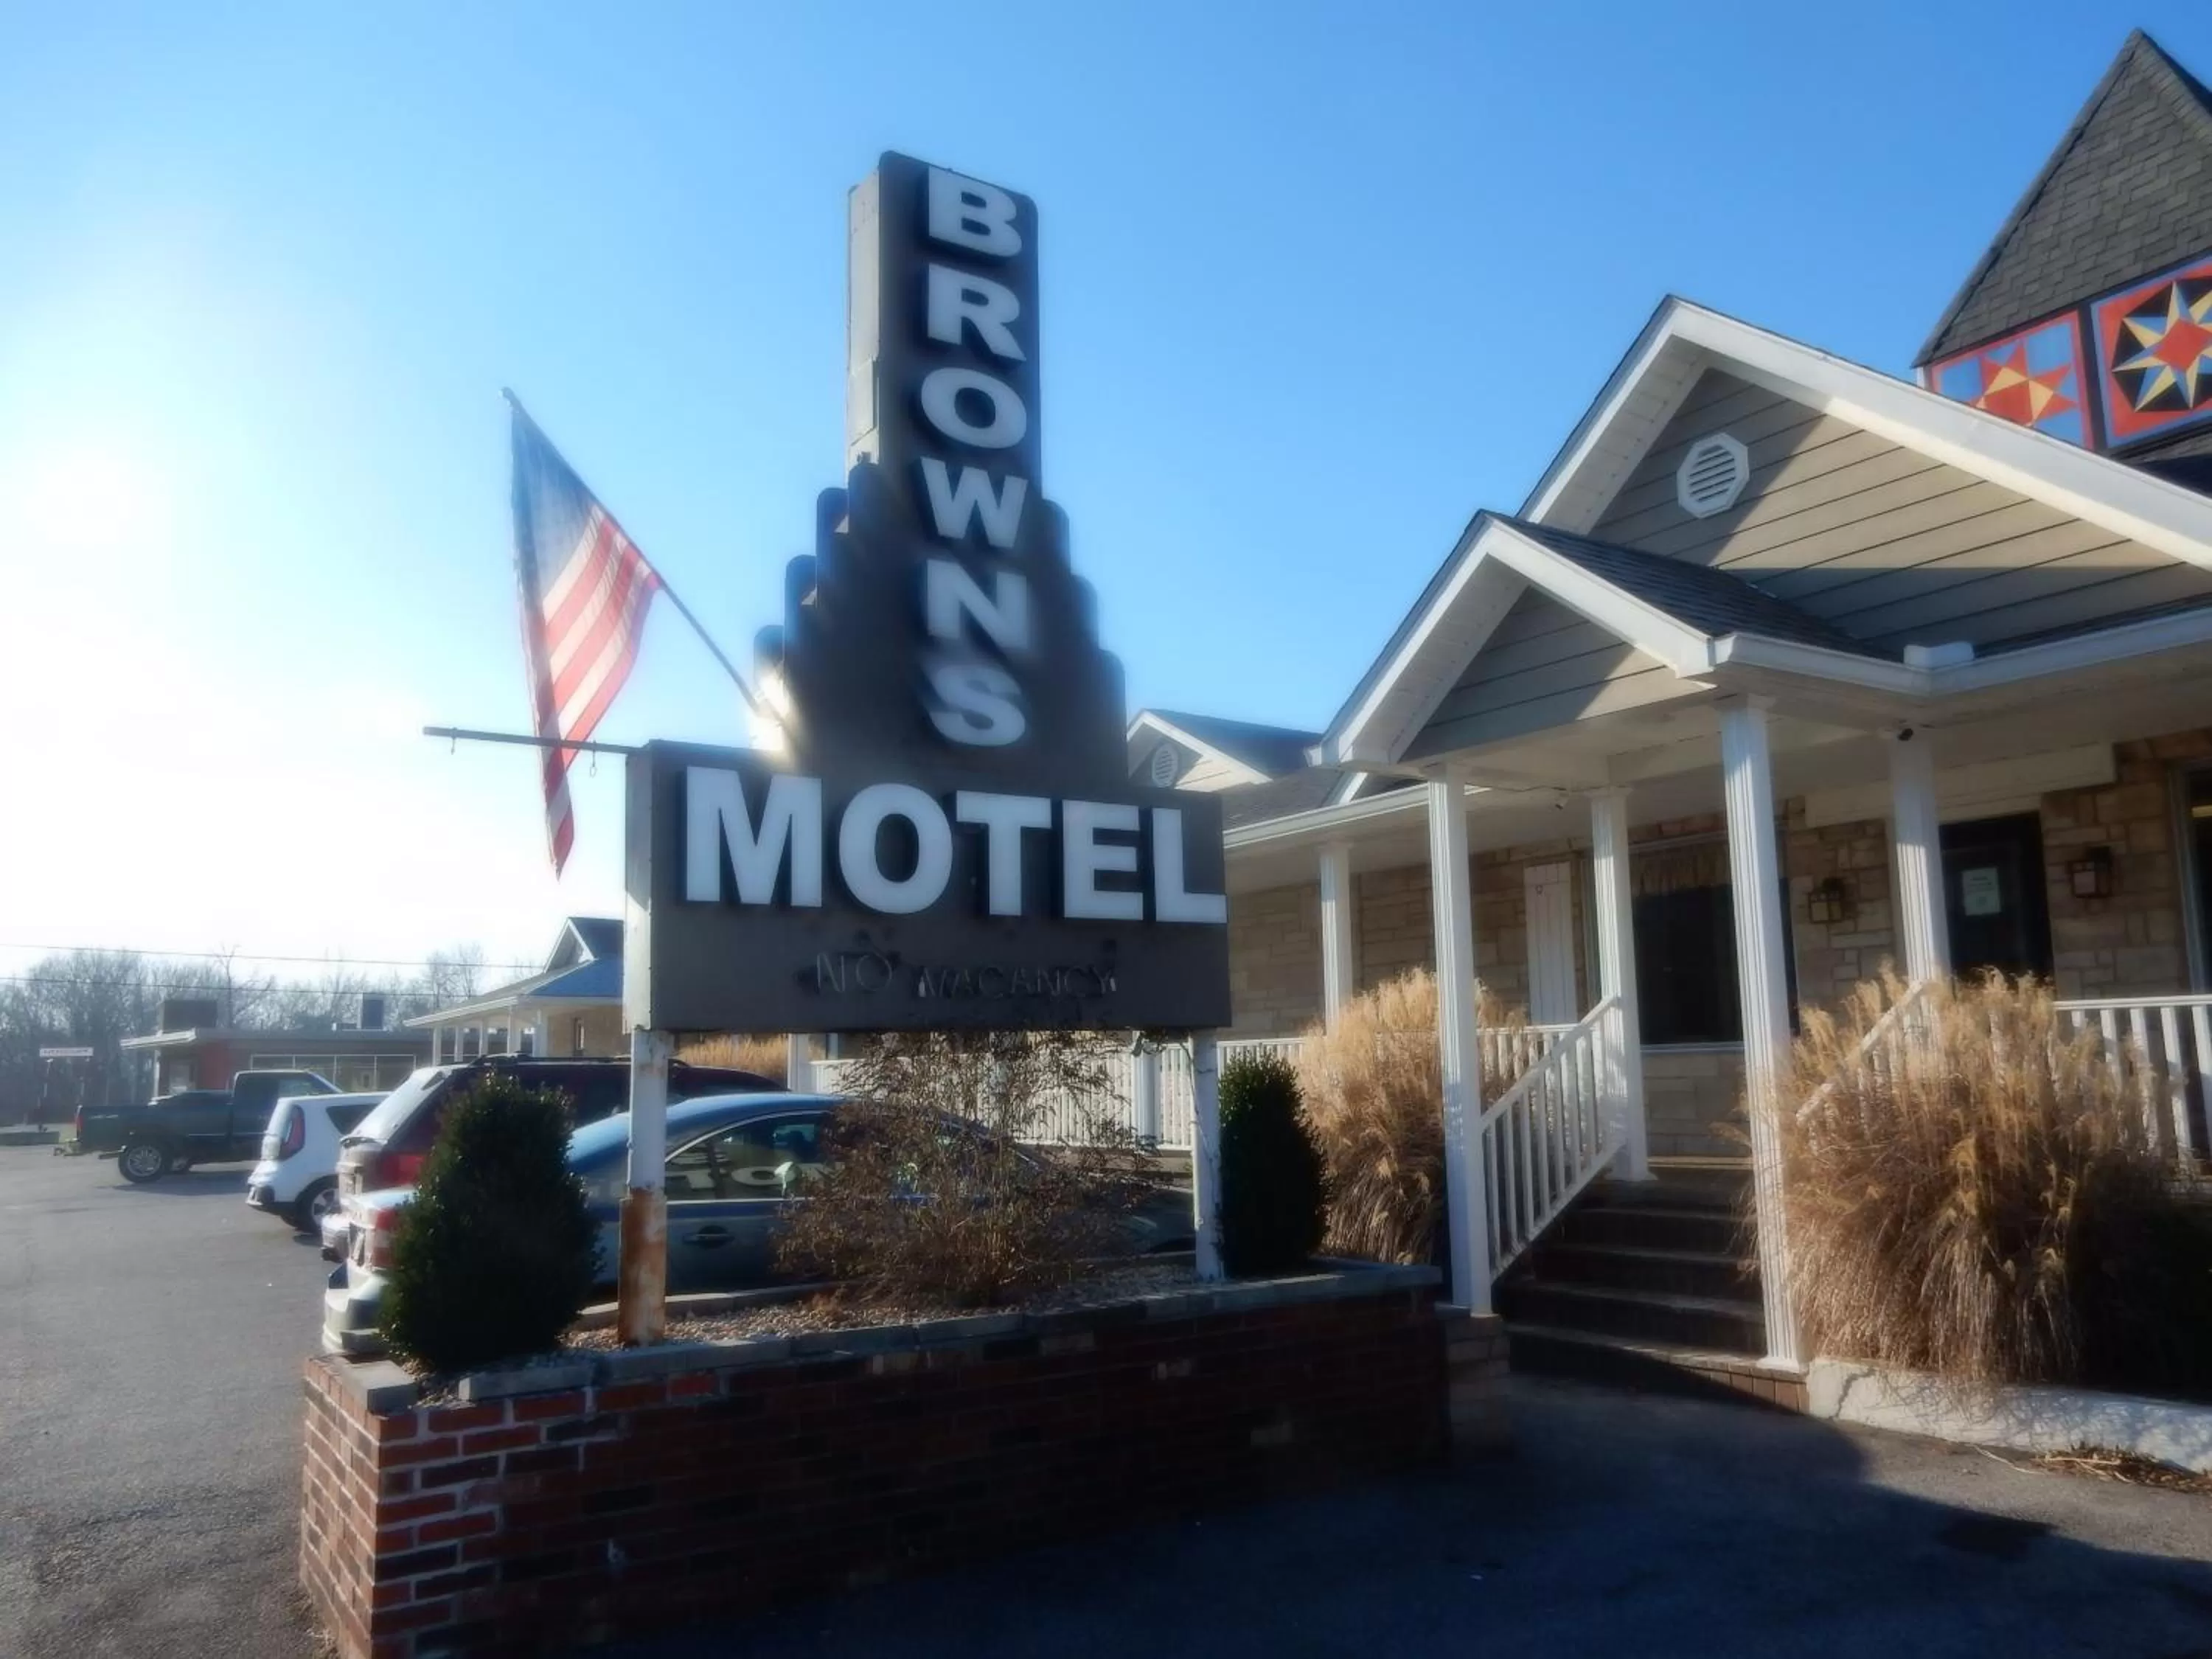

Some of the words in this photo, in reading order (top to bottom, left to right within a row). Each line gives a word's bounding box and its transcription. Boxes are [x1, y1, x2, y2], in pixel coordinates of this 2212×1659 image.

[920, 167, 1028, 747] BROWNS
[685, 765, 1228, 924] MOTEL
[815, 952, 894, 992] NO
[919, 965, 1116, 998] VACANCY
